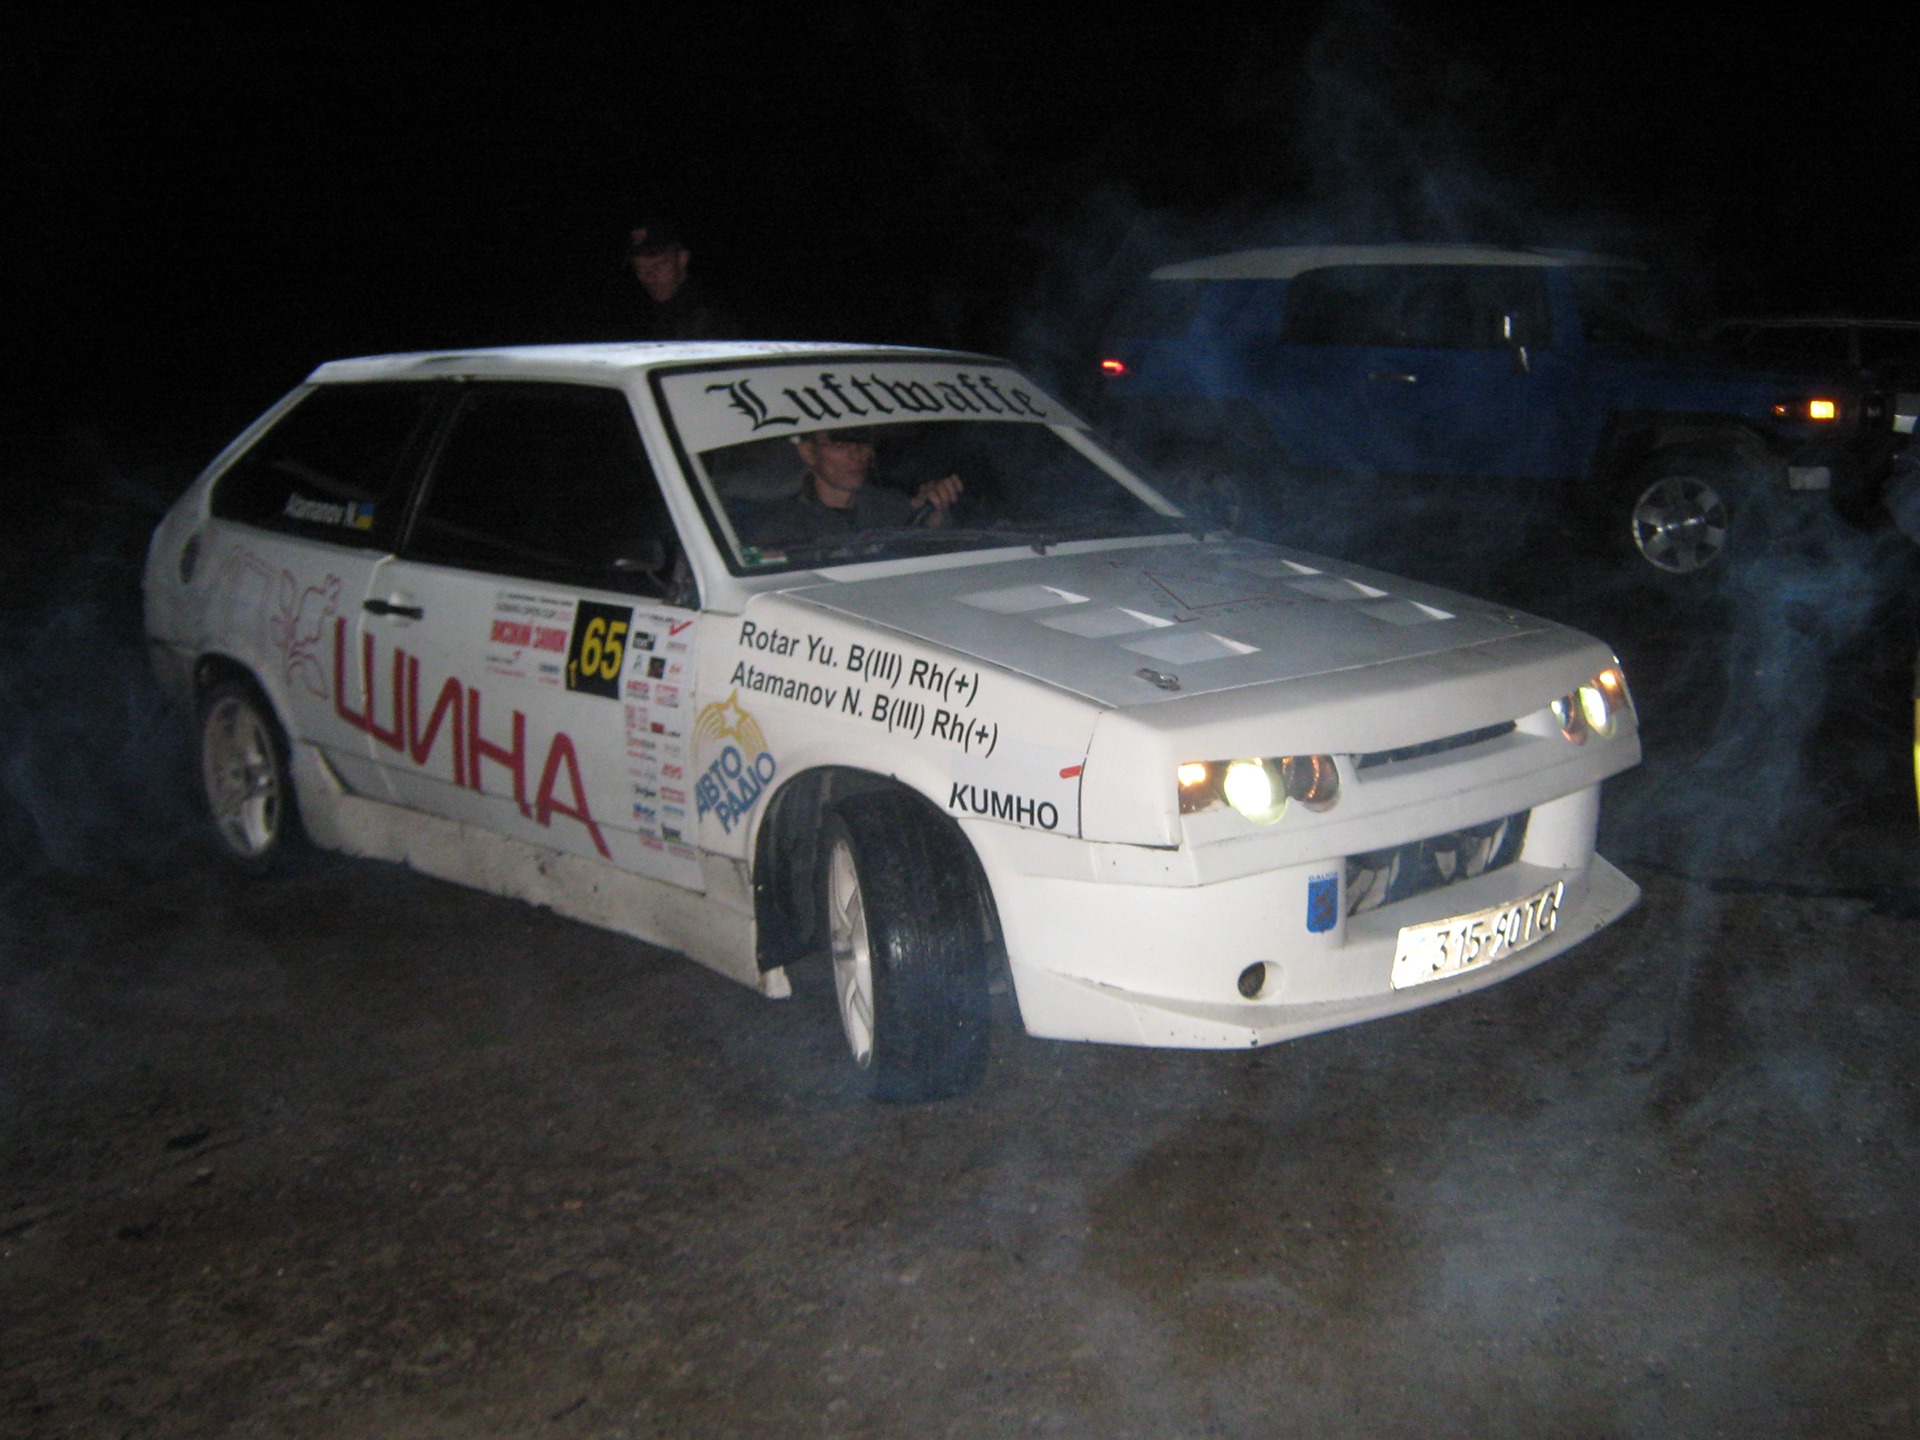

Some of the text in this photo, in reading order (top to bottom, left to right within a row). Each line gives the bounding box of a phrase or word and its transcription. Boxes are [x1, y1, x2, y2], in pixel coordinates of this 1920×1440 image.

[705, 372, 1047, 431] Luftwaffe
[581, 617, 627, 680] 65
[739, 621, 979, 707] Rotar Yu. B(III) Rh(+)
[333, 618, 612, 861] ШИНА
[730, 661, 836, 709] Atamanov
[841, 686, 863, 717] N.
[871, 696, 925, 739] B(III)
[931, 711, 998, 758] Rh(+)
[948, 782, 1059, 831] KUMHO
